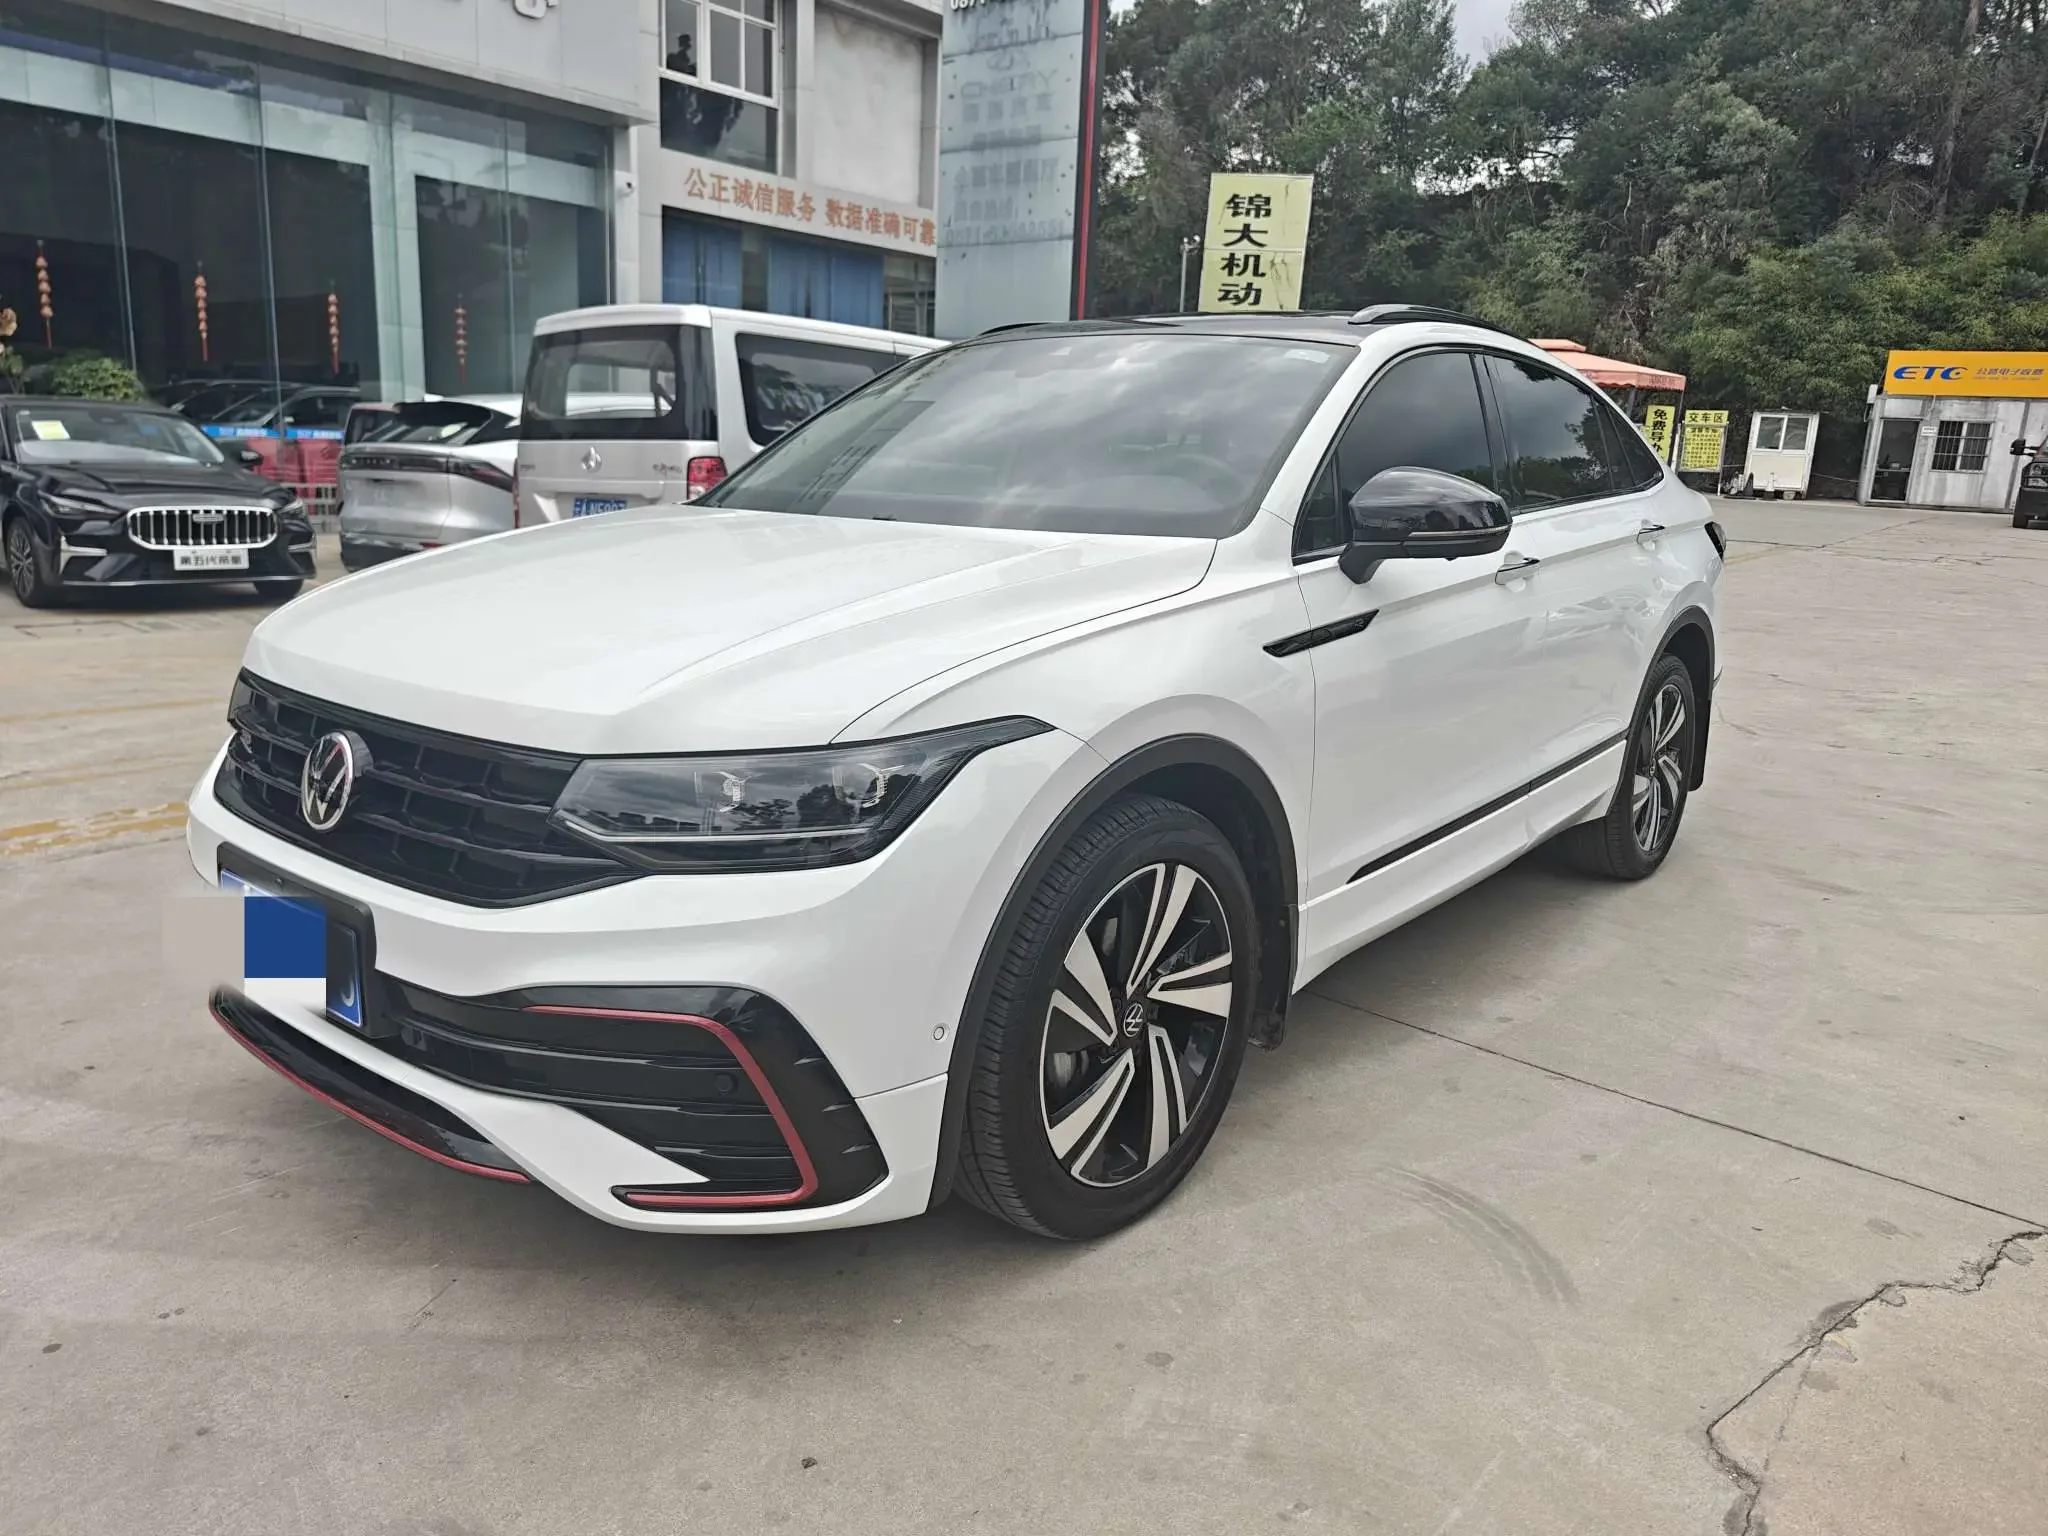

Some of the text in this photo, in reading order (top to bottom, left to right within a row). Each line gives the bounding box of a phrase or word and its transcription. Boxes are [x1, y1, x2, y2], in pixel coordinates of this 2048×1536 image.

[684, 168, 816, 222] 公正诚信服务
[825, 197, 937, 246] 数据准确可靠
[1217, 193, 1272, 306] 锦大机动
[1893, 366, 1968, 380] ETC
[1689, 412, 1723, 423] 交车区
